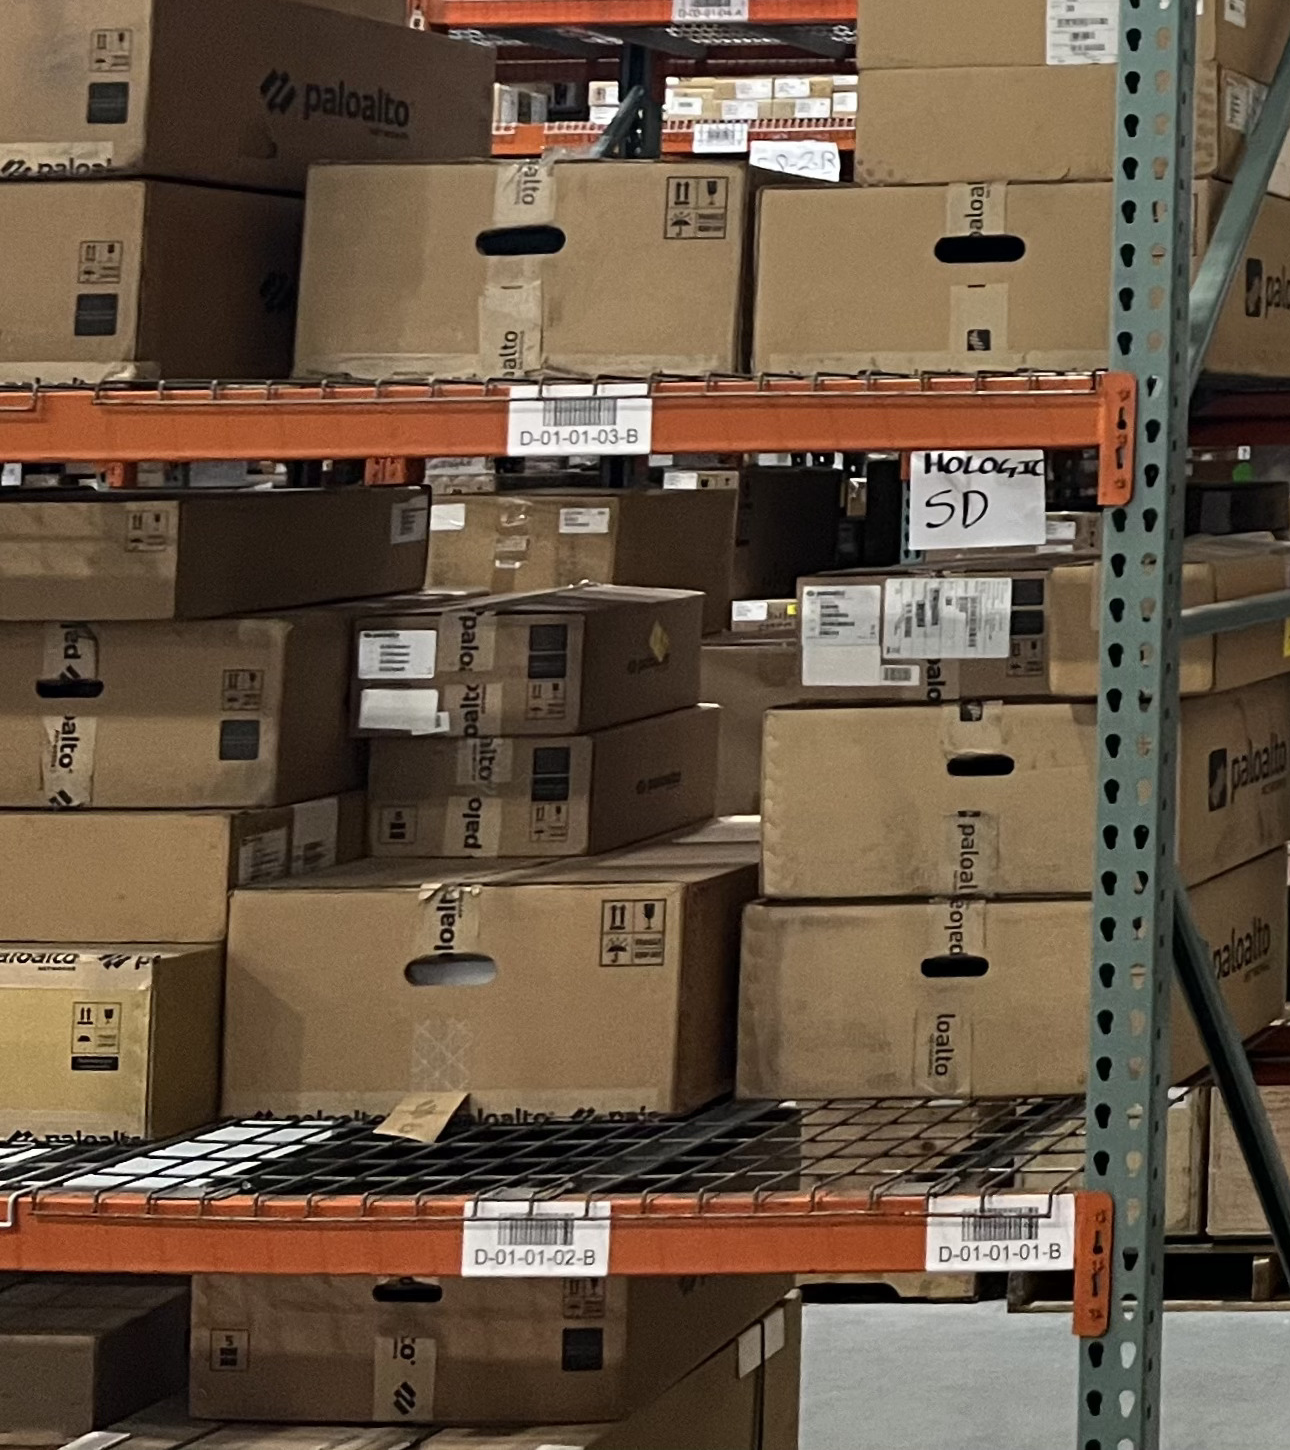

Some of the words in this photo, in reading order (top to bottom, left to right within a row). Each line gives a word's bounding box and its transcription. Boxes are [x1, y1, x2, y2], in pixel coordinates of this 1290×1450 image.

[303, 80, 410, 128] paloalto
[519, 429, 639, 446] D-01-01-03-B
[923, 452, 1045, 479] HOLOGIC
[925, 489, 990, 530] SD
[1230, 732, 1287, 804] paloalto
[473, 1248, 596, 1267] D-01-01-02-B
[938, 1244, 1062, 1264] D-01-01-01-B
